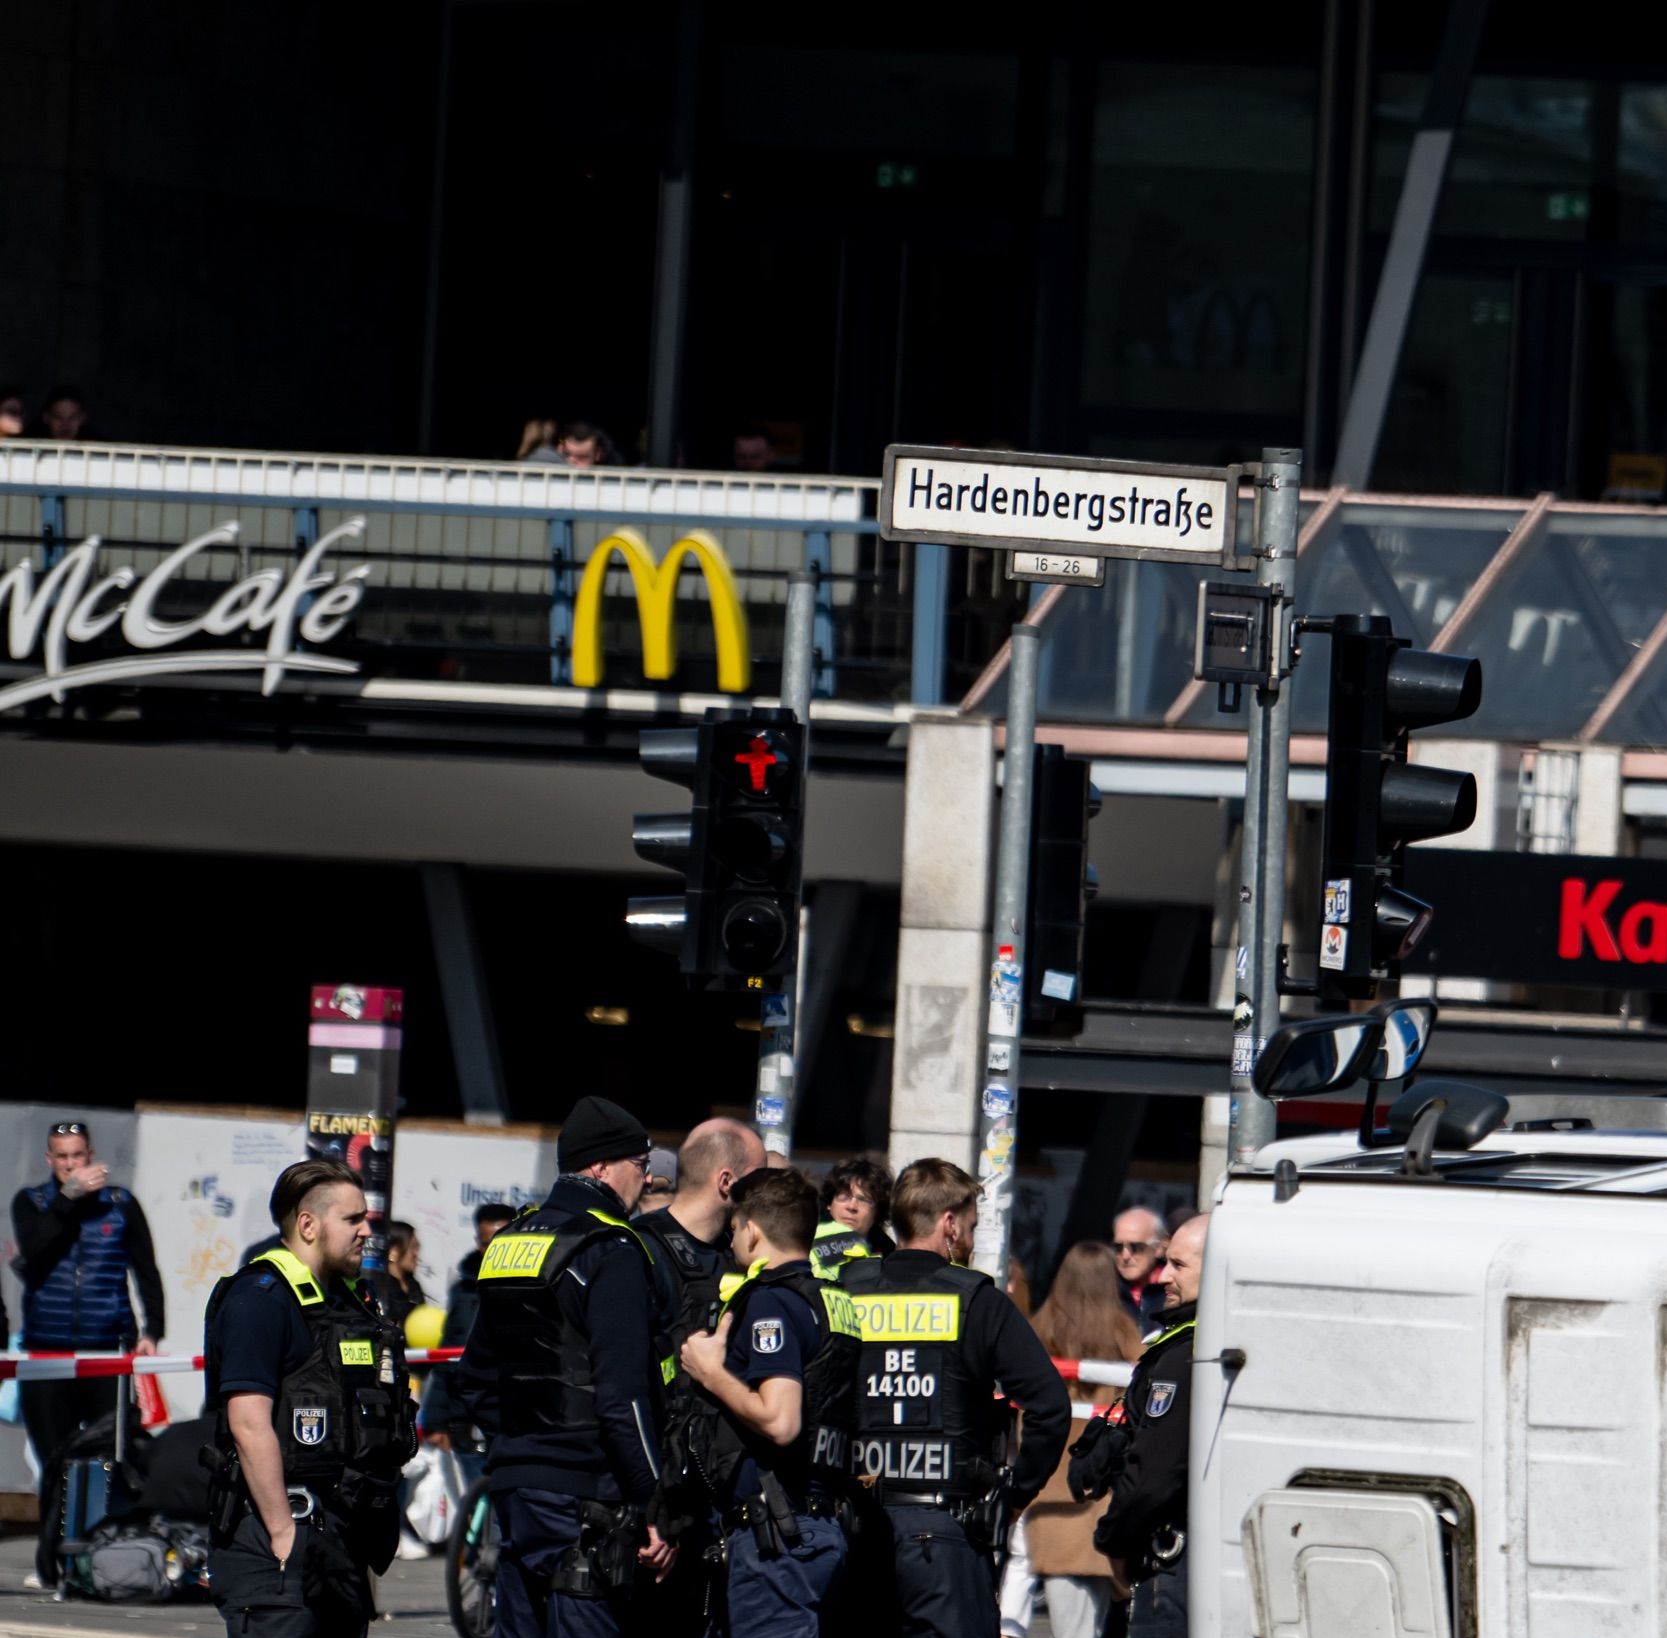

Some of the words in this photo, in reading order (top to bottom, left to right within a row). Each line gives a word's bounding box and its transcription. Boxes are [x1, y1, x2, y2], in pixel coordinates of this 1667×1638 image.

[908, 467, 1213, 537] Hardenbergstraße
[0, 516, 370, 702] McCafé
[481, 1241, 545, 1272] POLIZEI
[854, 1302, 953, 1334] POLIZEI
[344, 1347, 370, 1361] POLIZEI
[884, 1349, 917, 1373] BE
[866, 1375, 935, 1397] 14100
[296, 1409, 324, 1418] POLIZEI
[851, 1440, 950, 1480] POLIZEI
